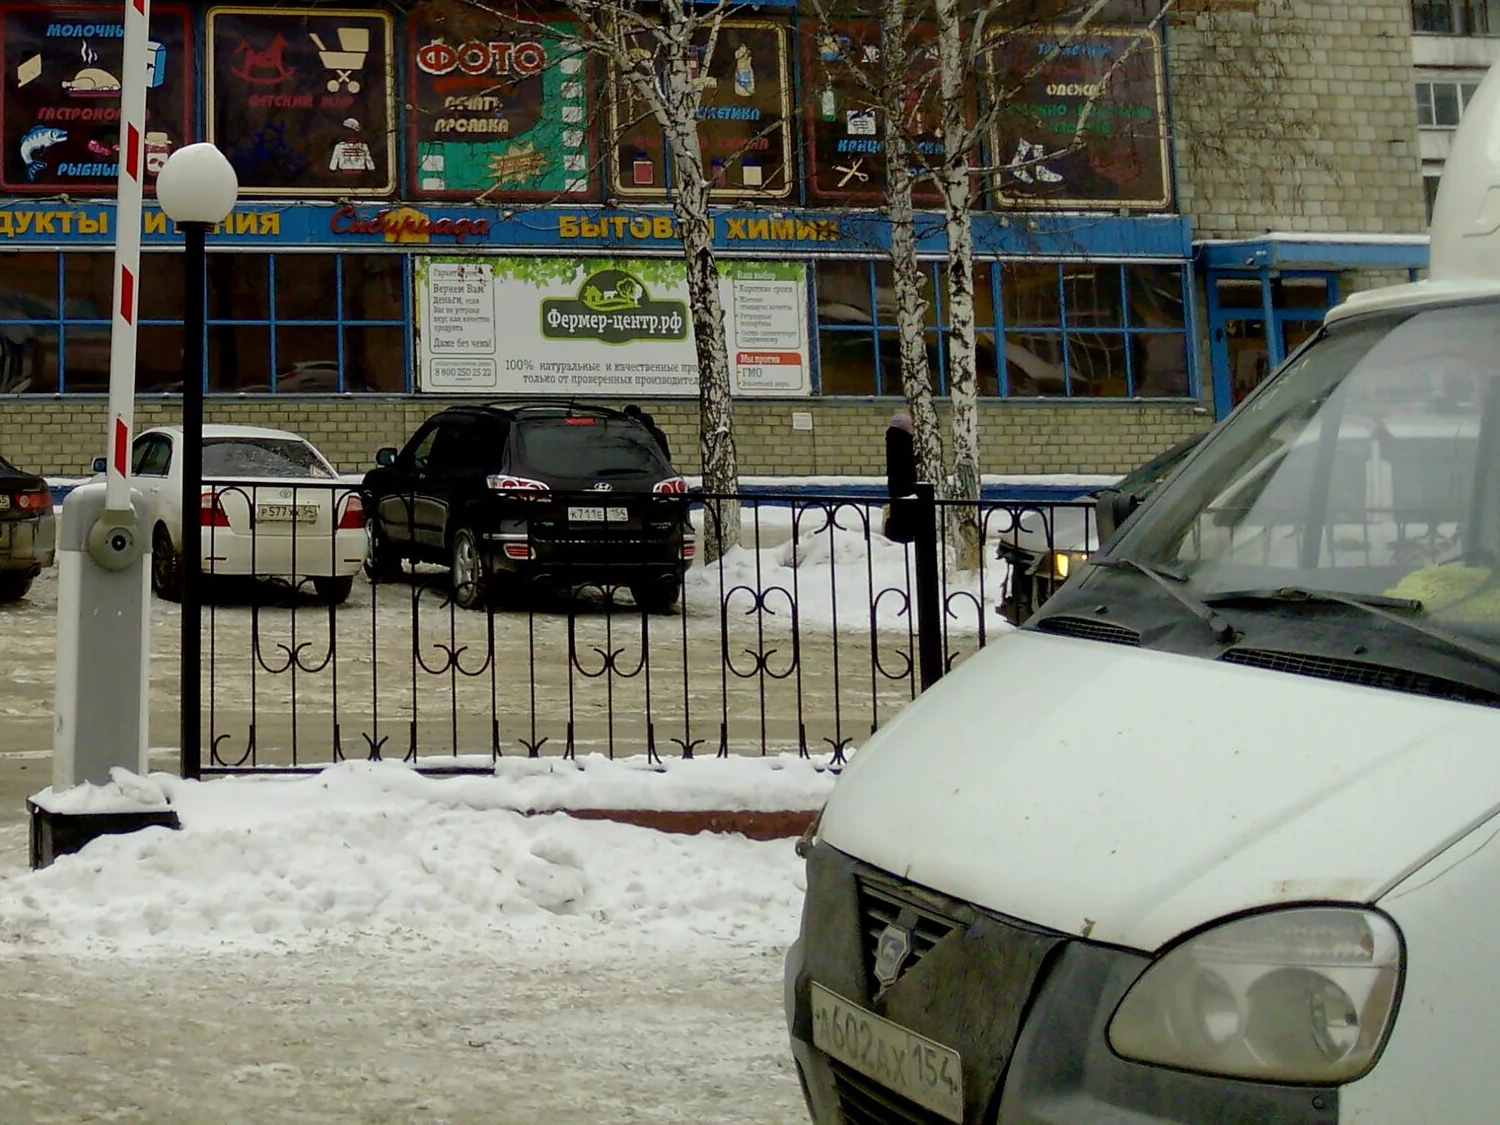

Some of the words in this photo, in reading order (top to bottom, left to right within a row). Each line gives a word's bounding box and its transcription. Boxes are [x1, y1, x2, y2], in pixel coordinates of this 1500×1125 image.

[46, 23, 125, 38] МОЛОЧНЫ
[416, 37, 548, 76] ФОТО
[57, 161, 120, 177] РЫБНЫ
[547, 308, 683, 334] Фермер-центр.рф
[505, 359, 534, 371] 100%
[539, 362, 601, 374] натуральные
[614, 362, 679, 373] качественные
[742, 367, 763, 378] ГМО
[523, 375, 556, 384] только
[558, 375, 569, 384] от
[571, 375, 633, 387] проверенных
